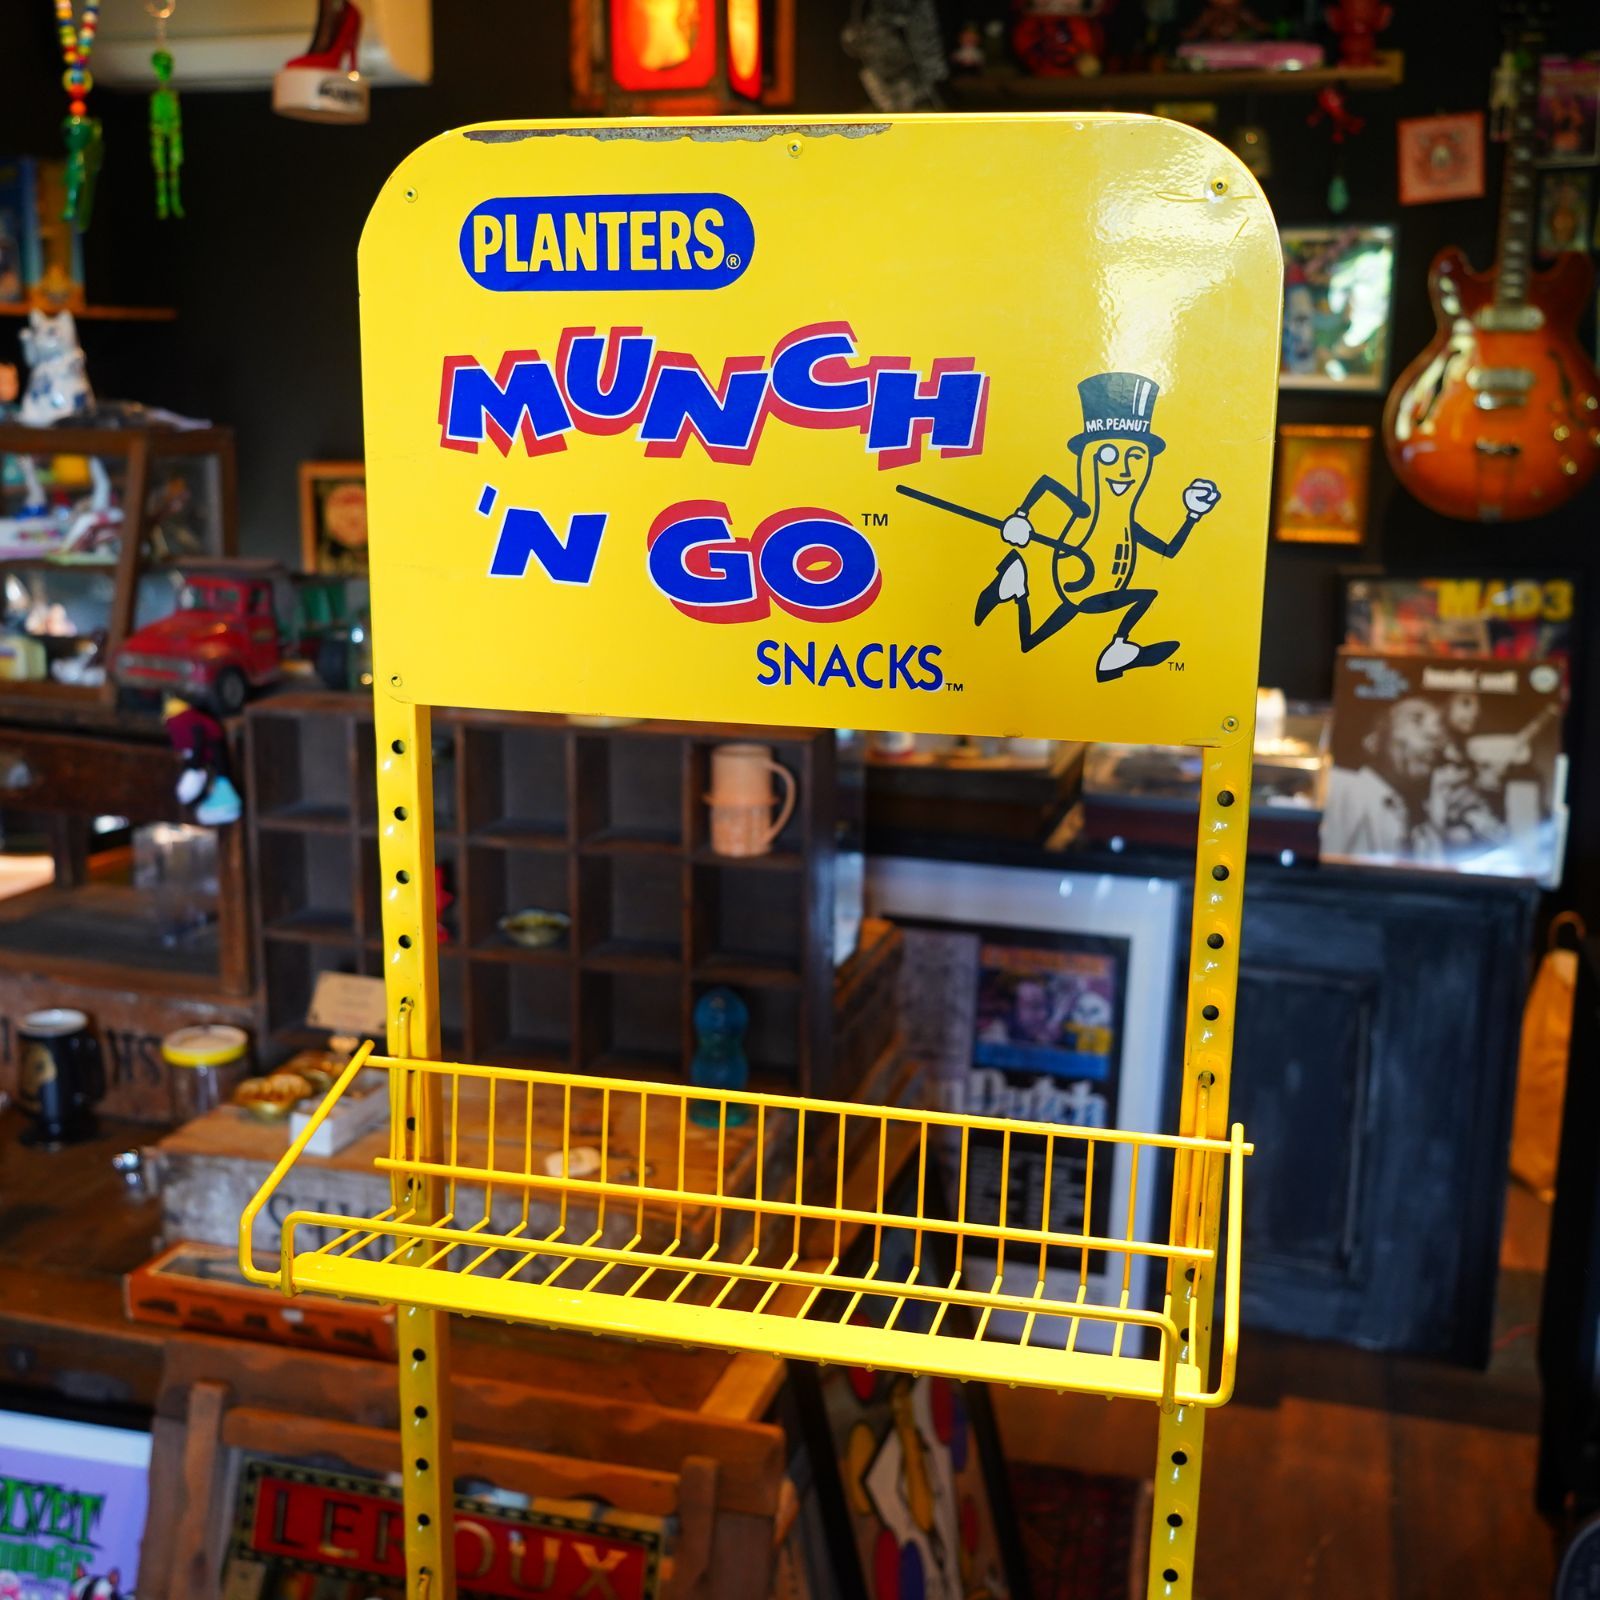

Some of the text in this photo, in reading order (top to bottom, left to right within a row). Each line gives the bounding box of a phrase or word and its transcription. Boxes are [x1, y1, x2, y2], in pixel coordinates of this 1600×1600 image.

[473, 209, 725, 273] PLANTERS
[437, 321, 990, 471] MUNCH
[477, 485, 608, 584] 'N
[647, 499, 883, 625] GO
[756, 640, 945, 692] SNACKS
